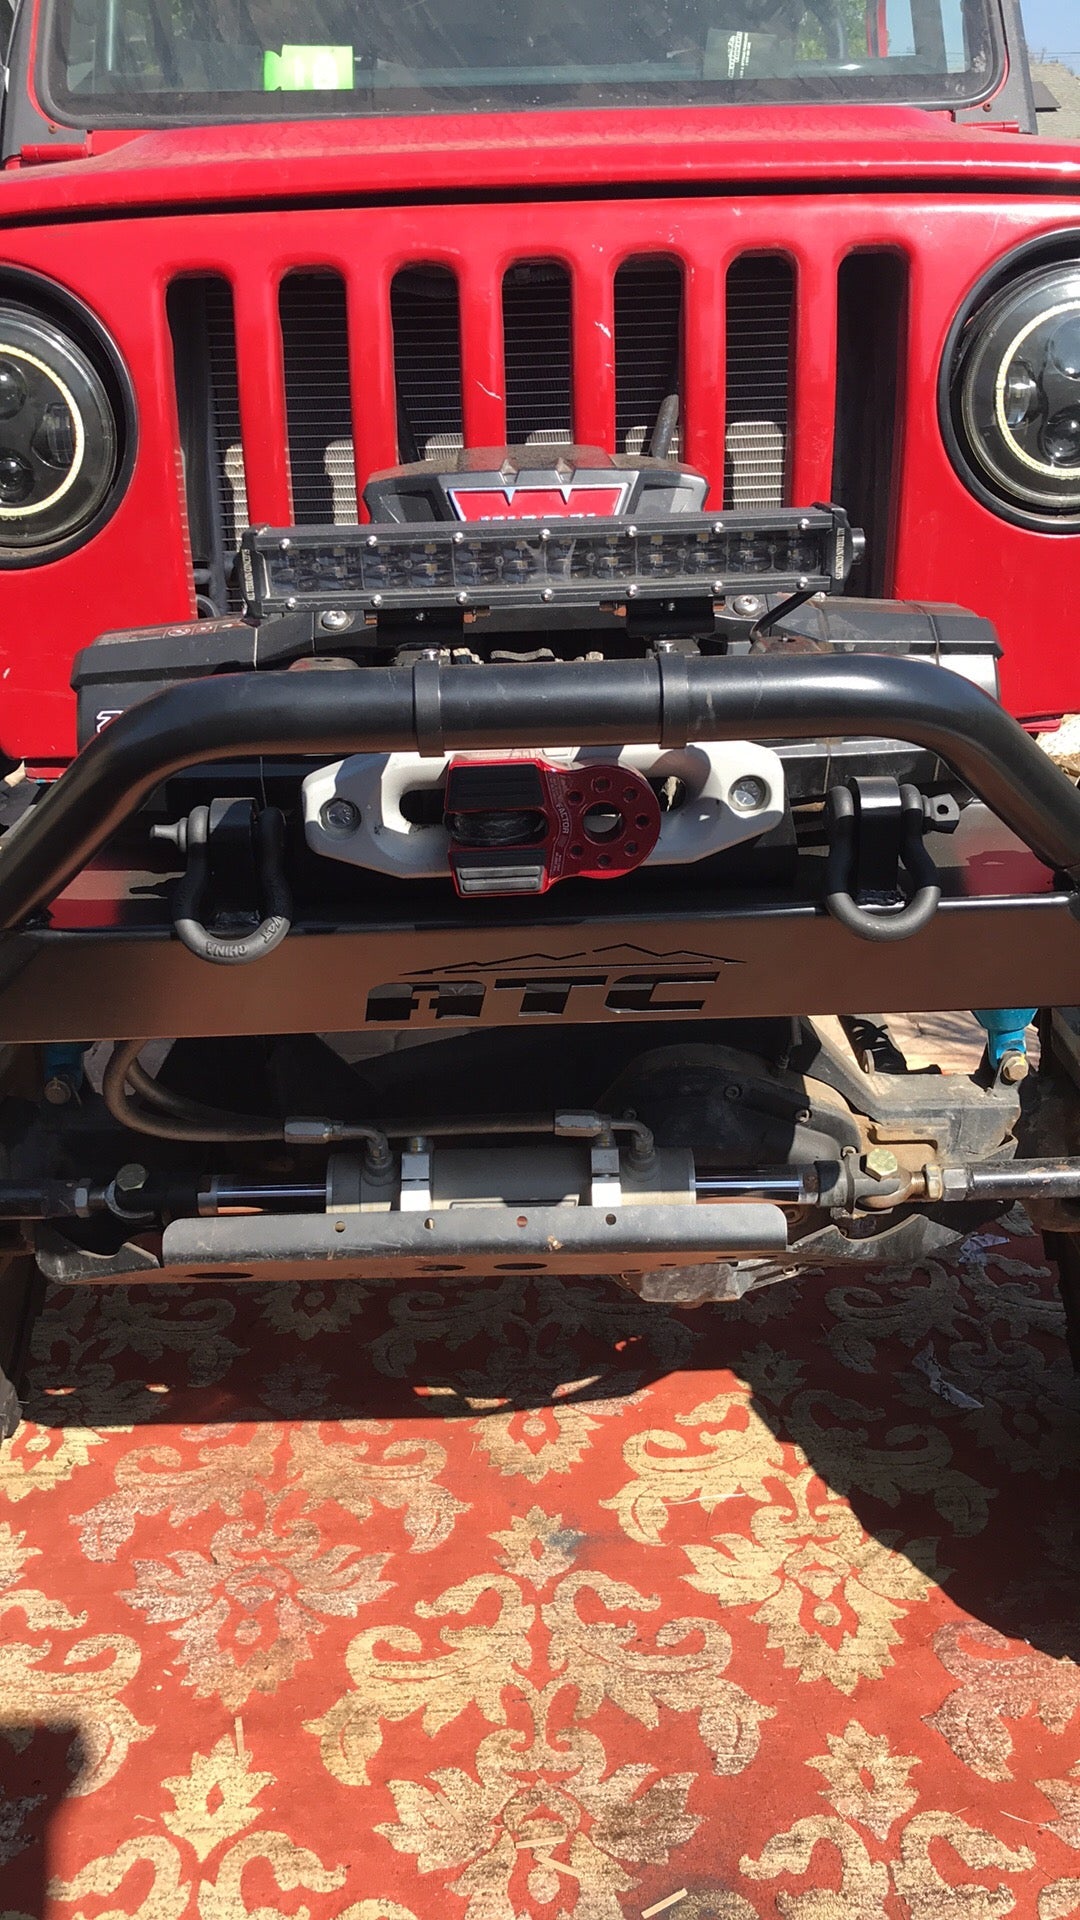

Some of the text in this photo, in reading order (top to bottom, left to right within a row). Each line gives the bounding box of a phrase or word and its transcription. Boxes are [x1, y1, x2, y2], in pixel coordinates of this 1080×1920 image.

[556, 803, 570, 834] FACTOR
[205, 941, 249, 958] CHINA
[365, 971, 720, 1022] ATC
